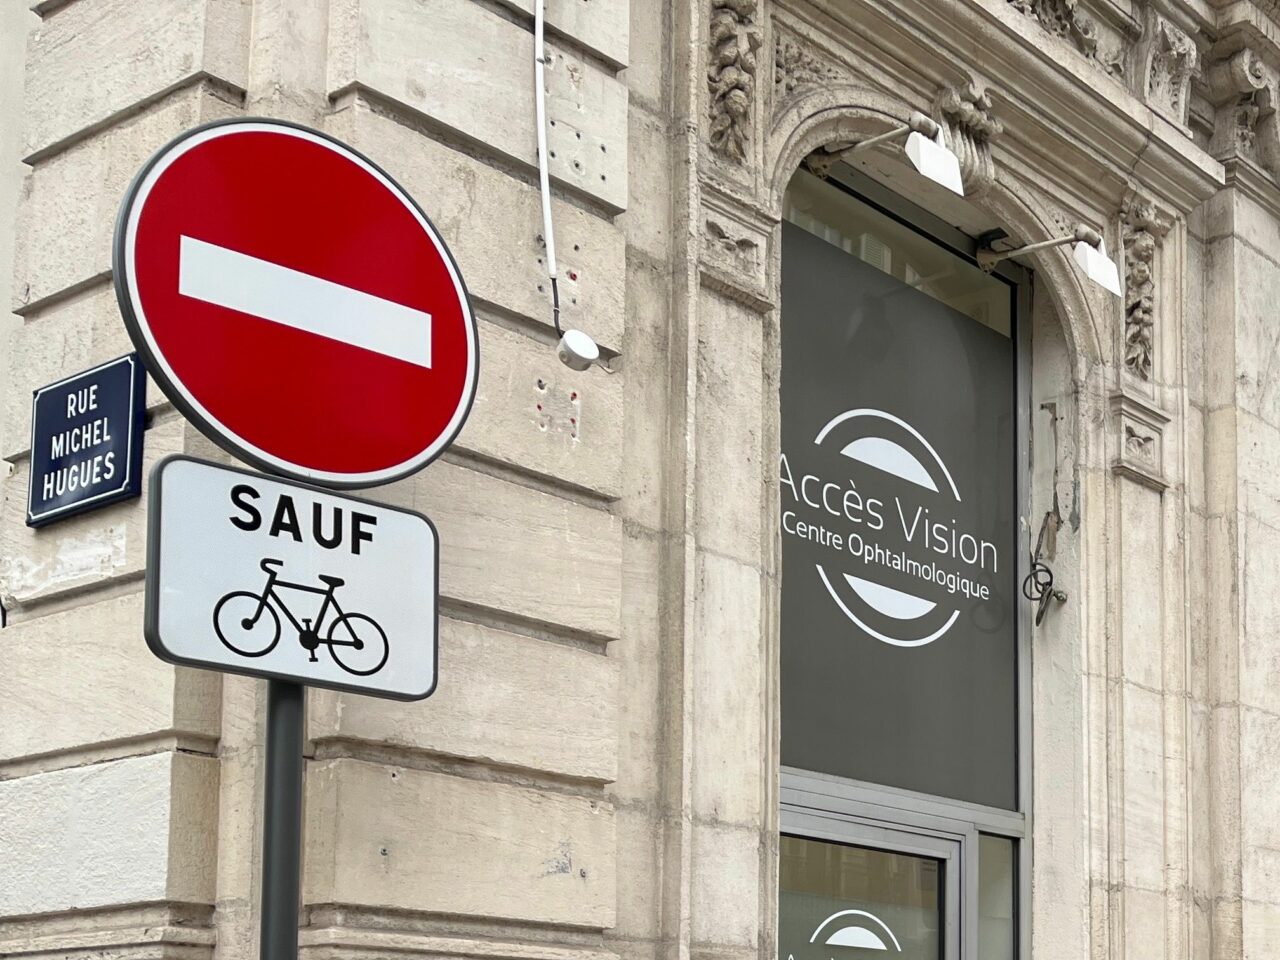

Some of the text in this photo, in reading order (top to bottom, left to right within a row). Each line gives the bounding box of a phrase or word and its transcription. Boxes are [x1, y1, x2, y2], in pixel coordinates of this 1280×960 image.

[67, 384, 98, 418] RUE
[51, 417, 111, 460] MICHEL
[43, 451, 115, 500] HUGUES
[229, 484, 377, 555] SAUF
[780, 453, 998, 573] Accès Vision
[782, 511, 990, 600] Centre Ophtalmologique
